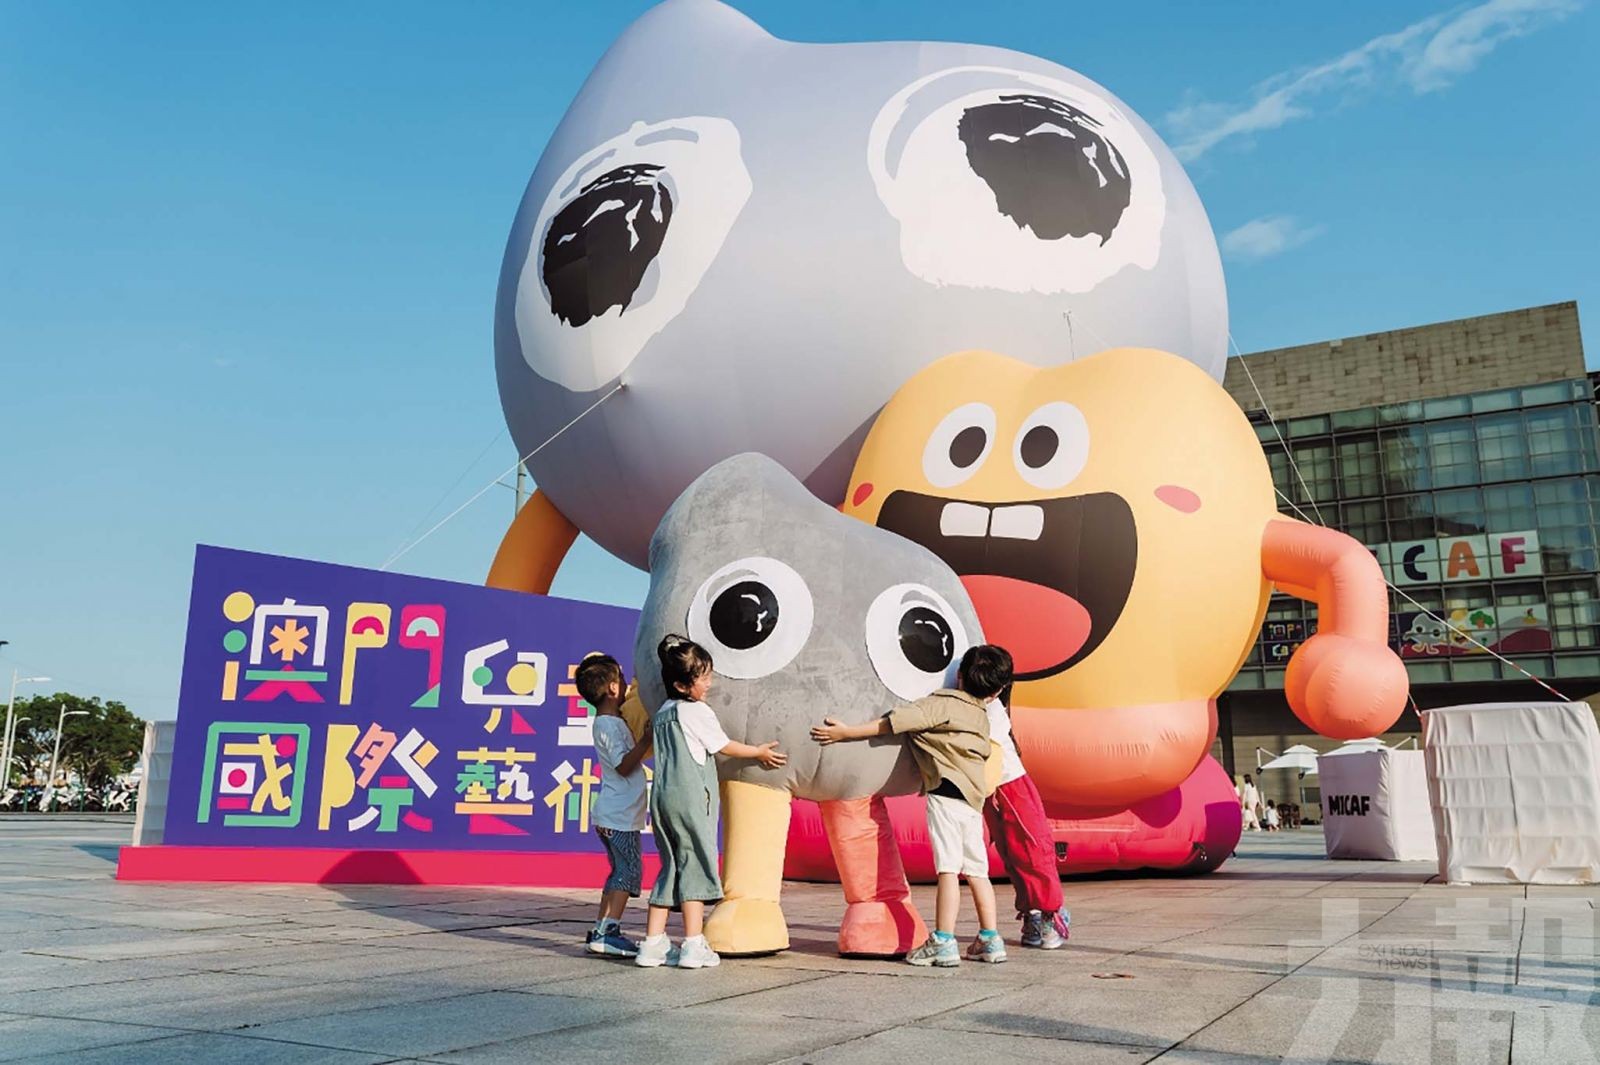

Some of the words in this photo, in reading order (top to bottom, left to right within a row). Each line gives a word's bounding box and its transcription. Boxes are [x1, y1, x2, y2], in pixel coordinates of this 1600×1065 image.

[1370, 537, 1526, 581] CAF
[197, 722, 653, 834] 國際藝術
[1328, 795, 1370, 816] MICAF
